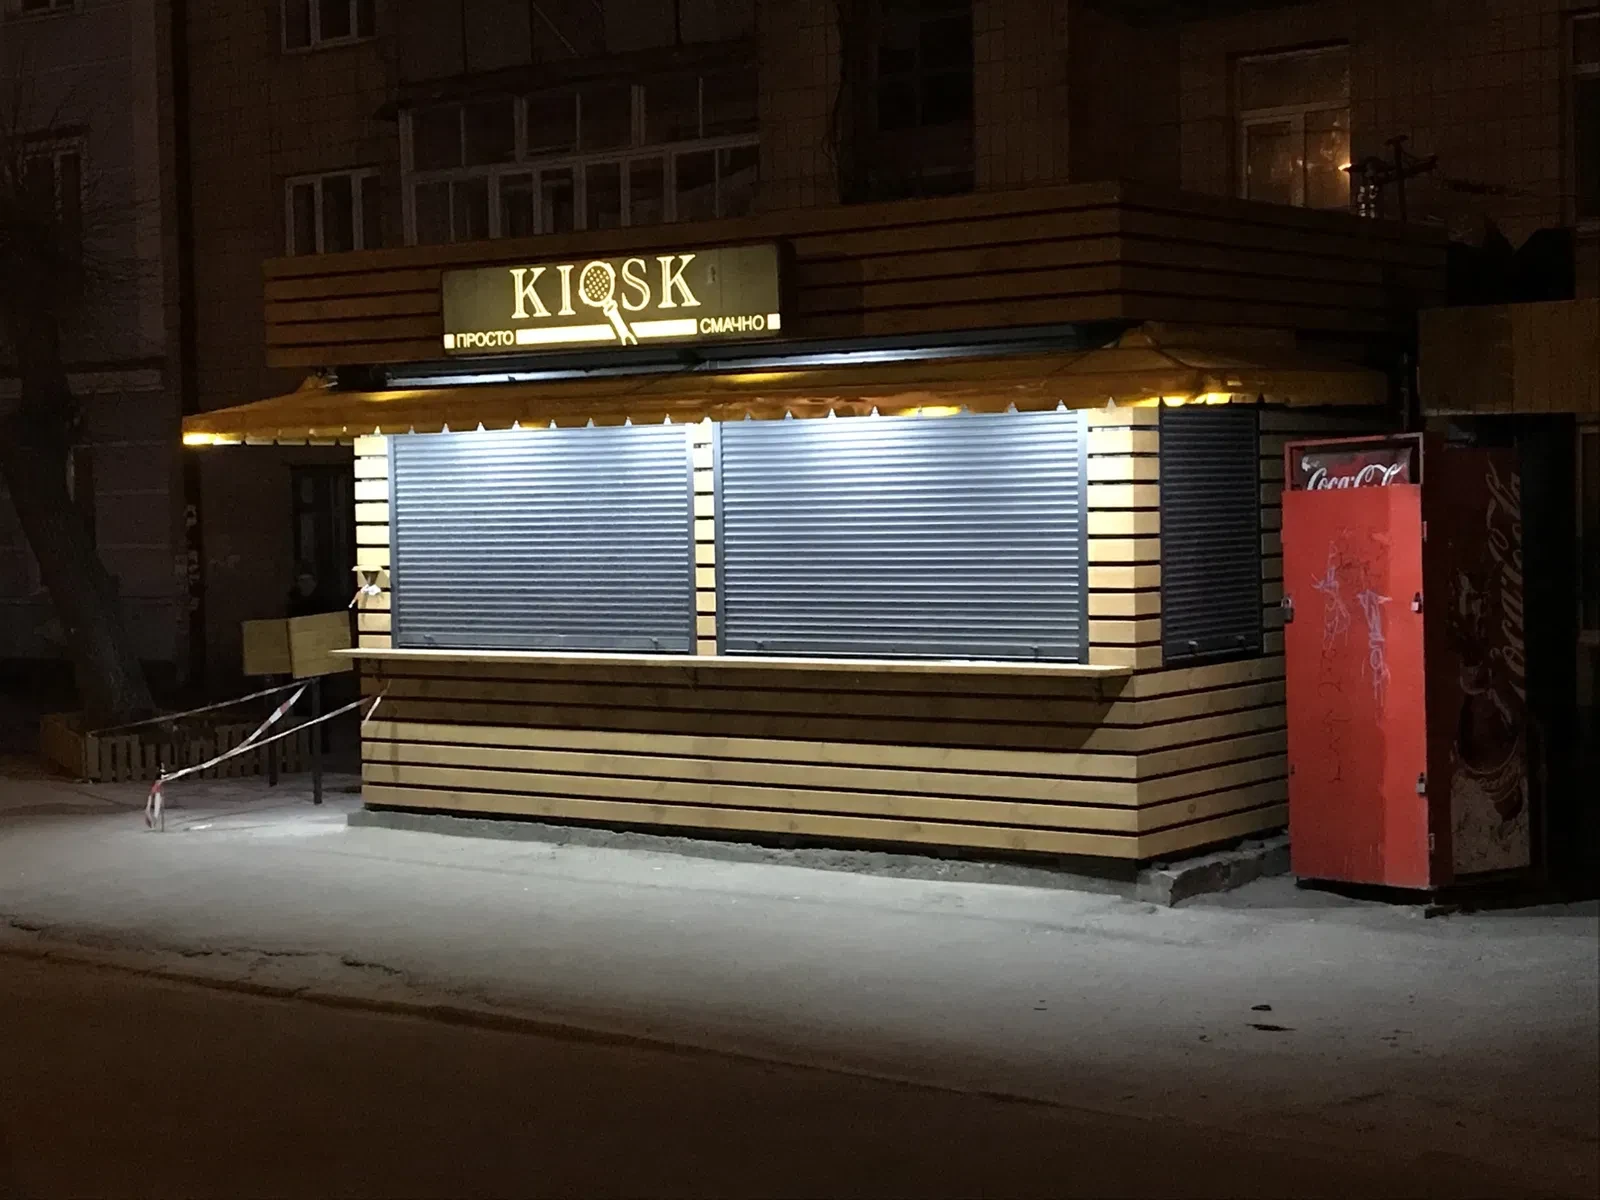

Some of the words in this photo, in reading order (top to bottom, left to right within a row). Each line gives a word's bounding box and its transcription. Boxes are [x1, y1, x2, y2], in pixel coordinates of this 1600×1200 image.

[509, 254, 701, 319] KIOSK
[456, 330, 514, 348] ПРОСТО
[700, 314, 765, 334] СМАЧНО
